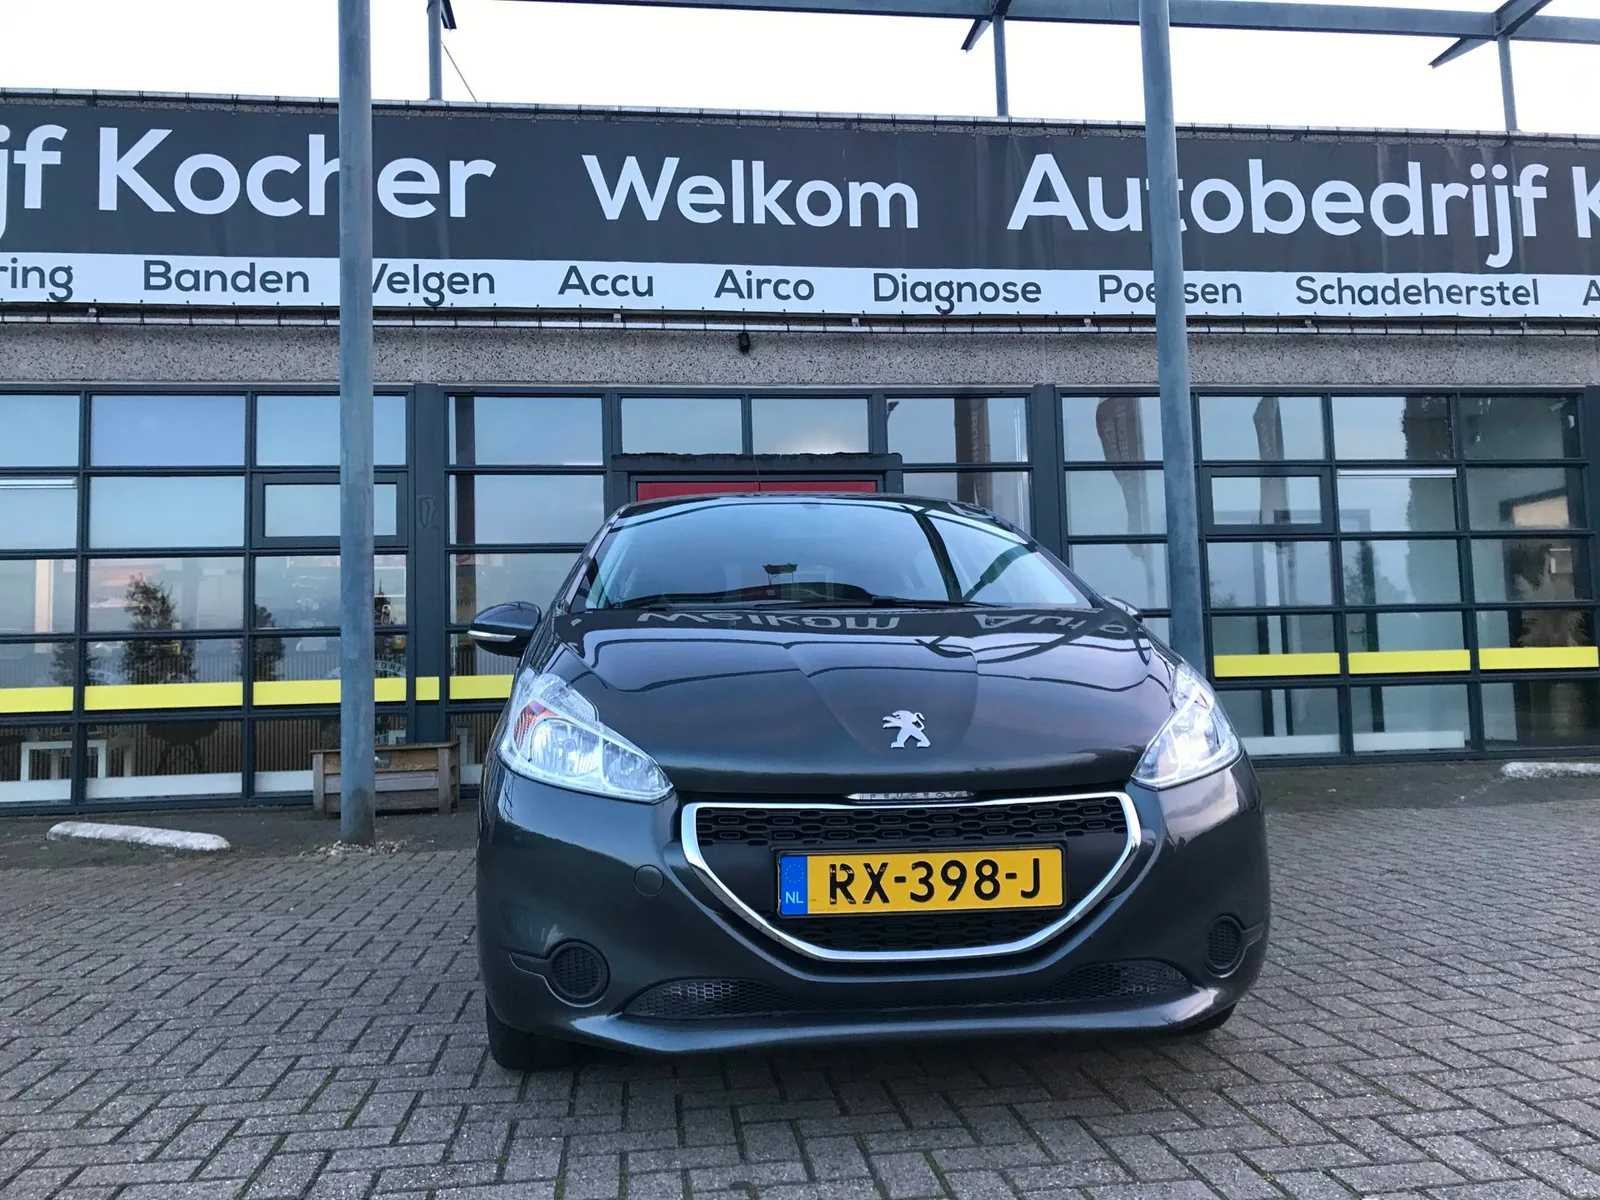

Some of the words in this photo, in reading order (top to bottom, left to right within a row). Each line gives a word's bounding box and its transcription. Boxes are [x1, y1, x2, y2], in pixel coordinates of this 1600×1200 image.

[98, 127, 497, 218] Kocher
[581, 154, 919, 229] Welkom
[1007, 153, 1549, 268] Auobedrijf
[143, 260, 310, 293] Banden
[558, 265, 654, 298] Accu
[714, 269, 815, 301] Airco
[873, 272, 1042, 314] Diagnose
[1296, 275, 1540, 307] Schadeherstel
[785, 891, 804, 904] NL
[828, 858, 1041, 905] RX-398-J
